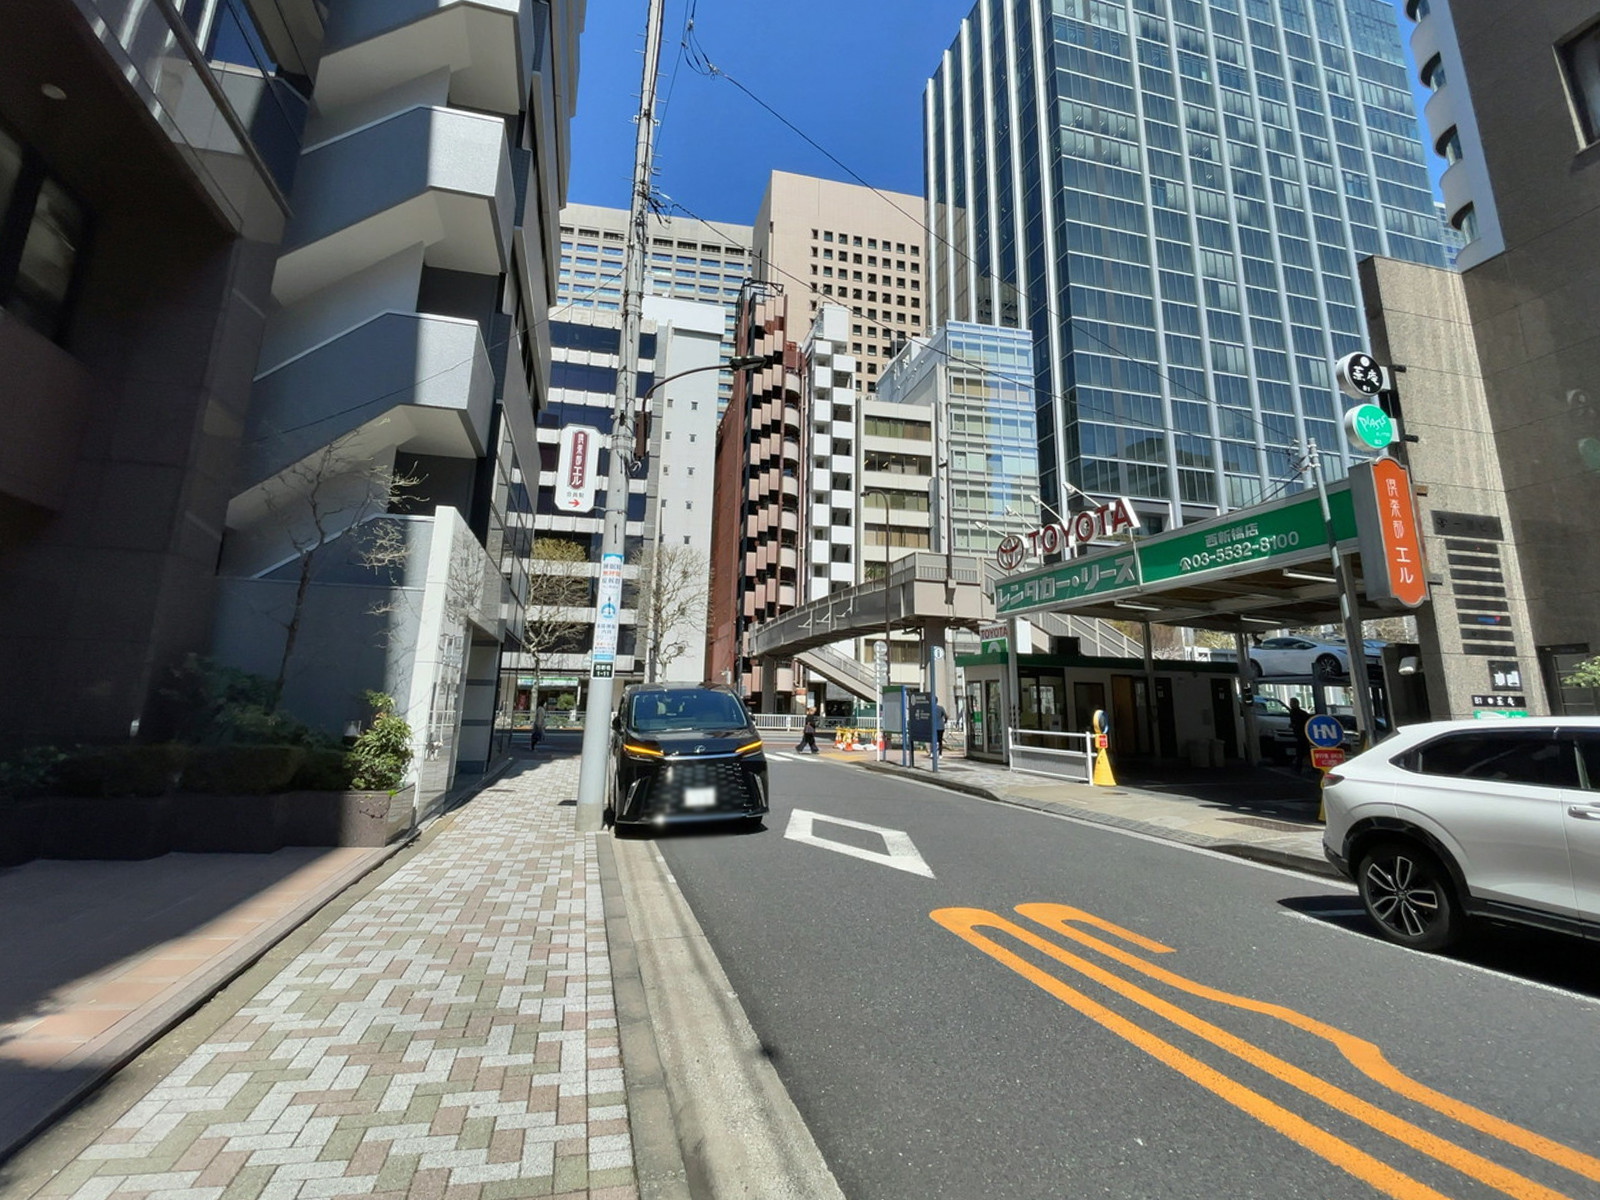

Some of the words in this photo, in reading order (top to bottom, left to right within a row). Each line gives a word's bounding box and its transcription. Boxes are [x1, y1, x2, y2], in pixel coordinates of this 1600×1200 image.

[1028, 498, 1137, 558] TOYOTA
[1204, 522, 1259, 548] 西新橋店
[997, 555, 1136, 609] レンタカー・リース
[981, 625, 1008, 639] TOYOTA
